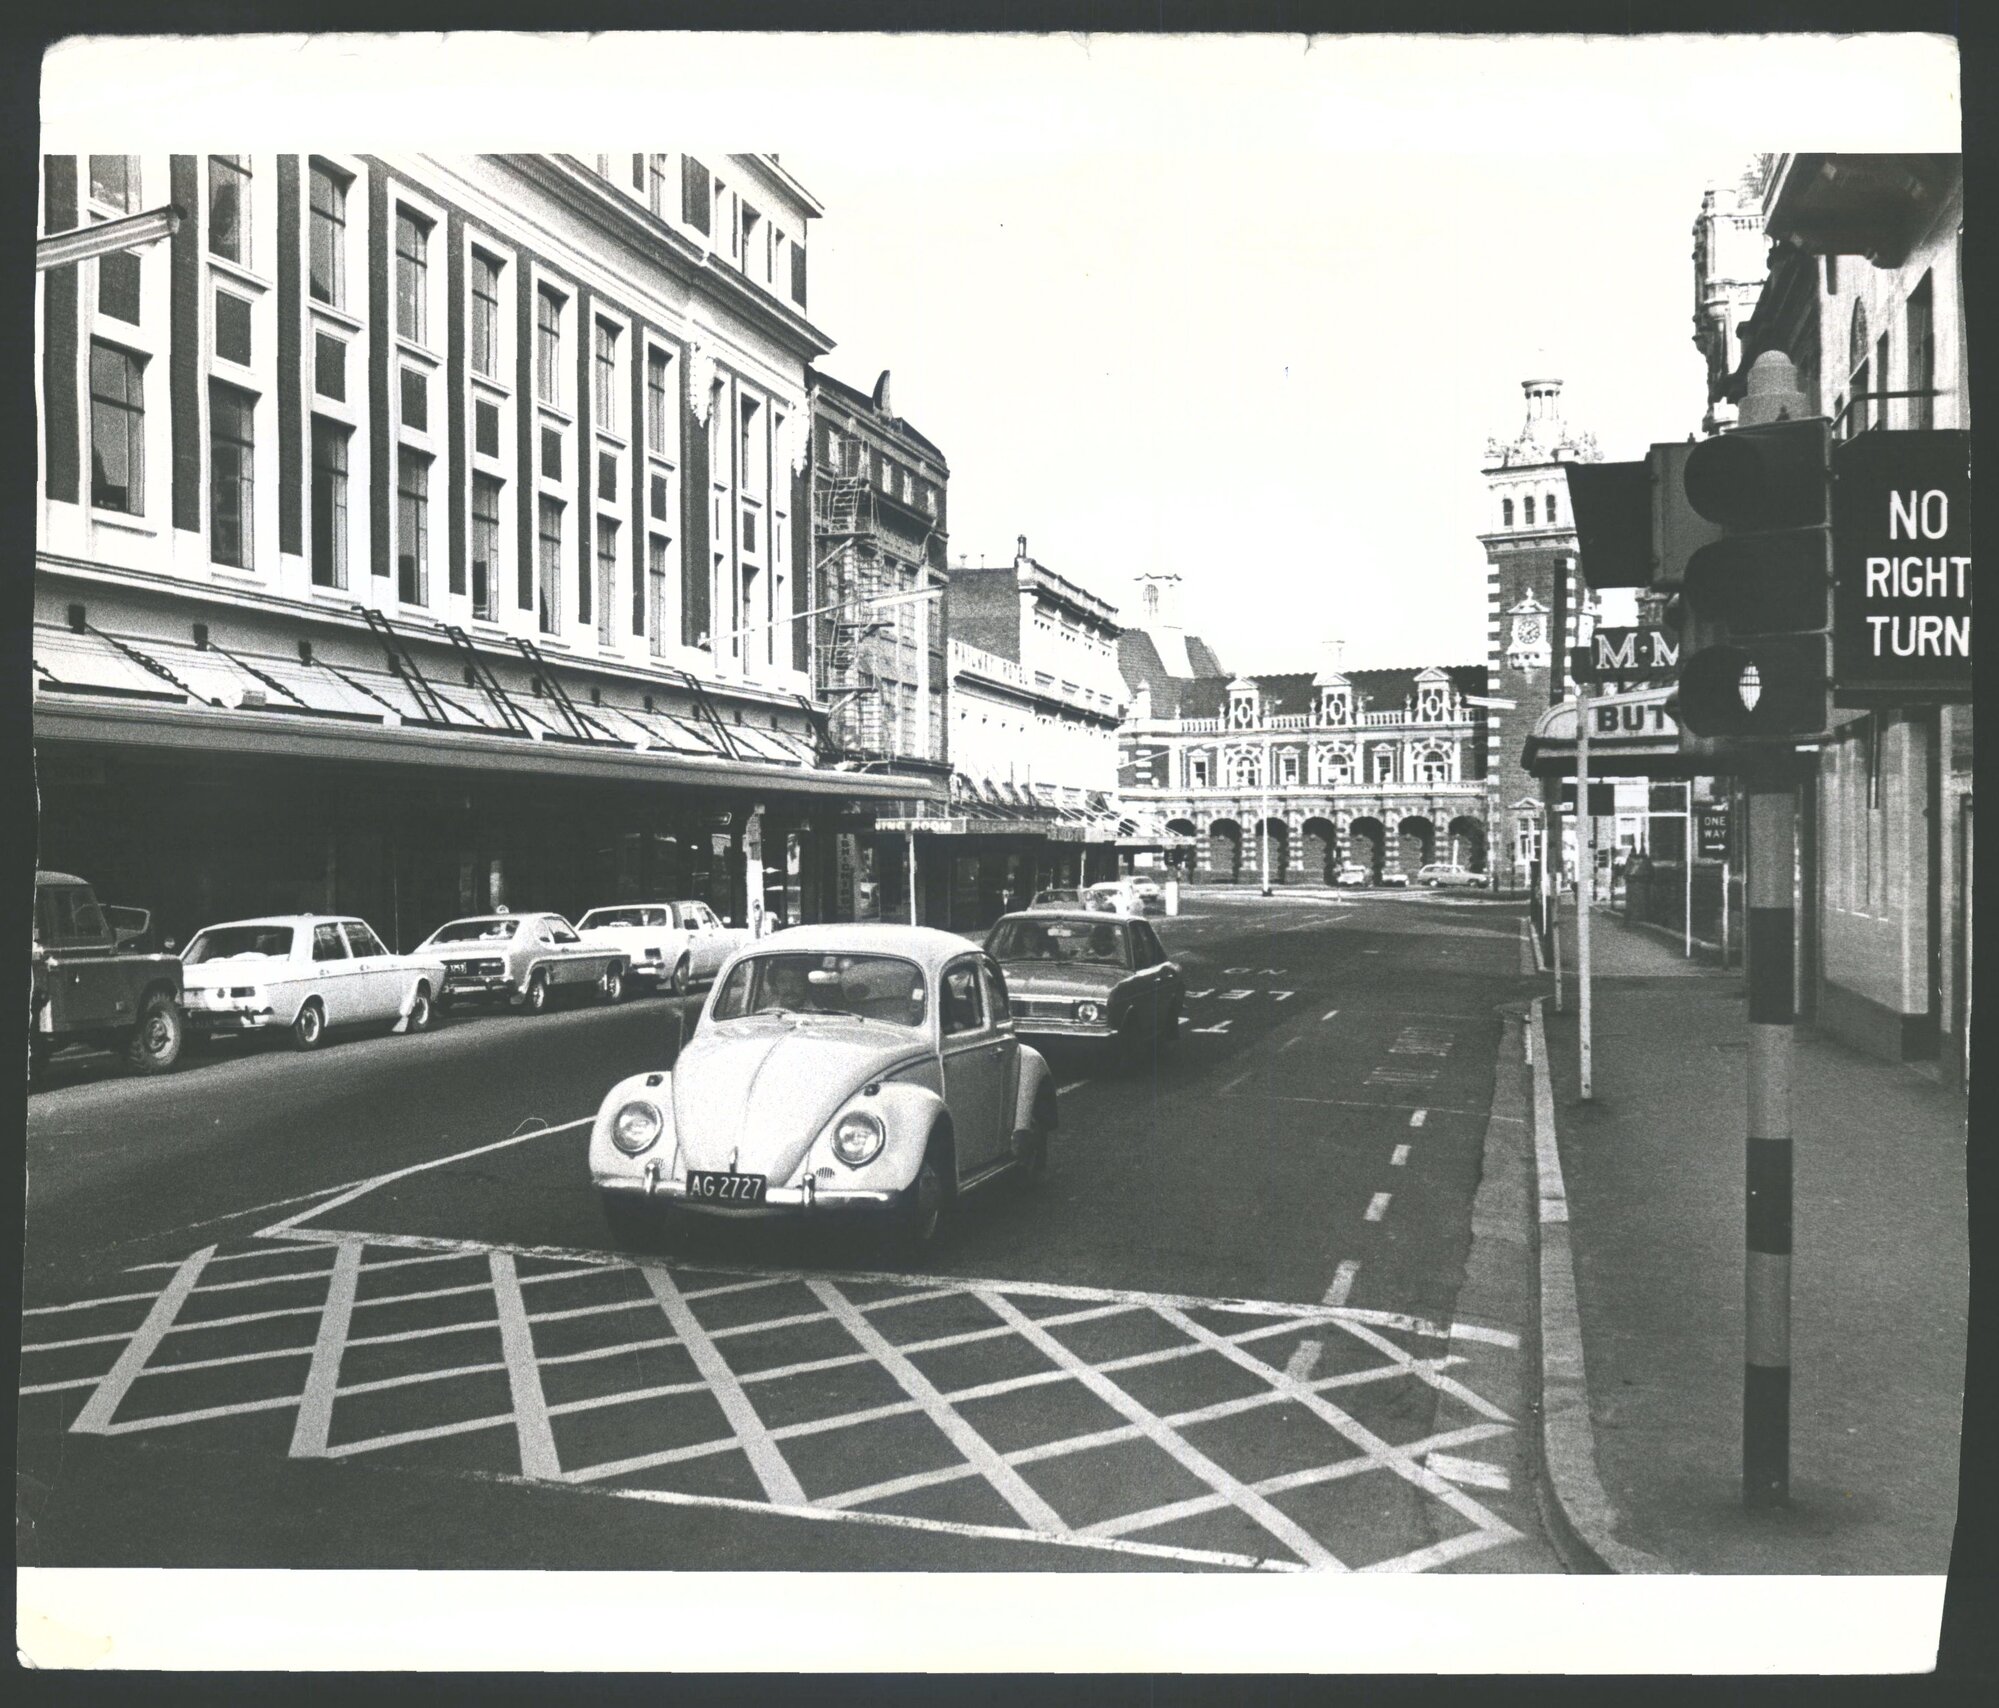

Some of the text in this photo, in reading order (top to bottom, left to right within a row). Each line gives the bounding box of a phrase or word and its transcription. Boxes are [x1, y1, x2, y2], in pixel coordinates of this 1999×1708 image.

[1889, 489, 1949, 540] NO
[1866, 556, 1972, 598] RIGHT
[1865, 615, 1971, 657] TURN
[1703, 816, 1727, 826] ONE
[1703, 829, 1727, 839] WAY
[690, 1175, 763, 1199] AG 2727
